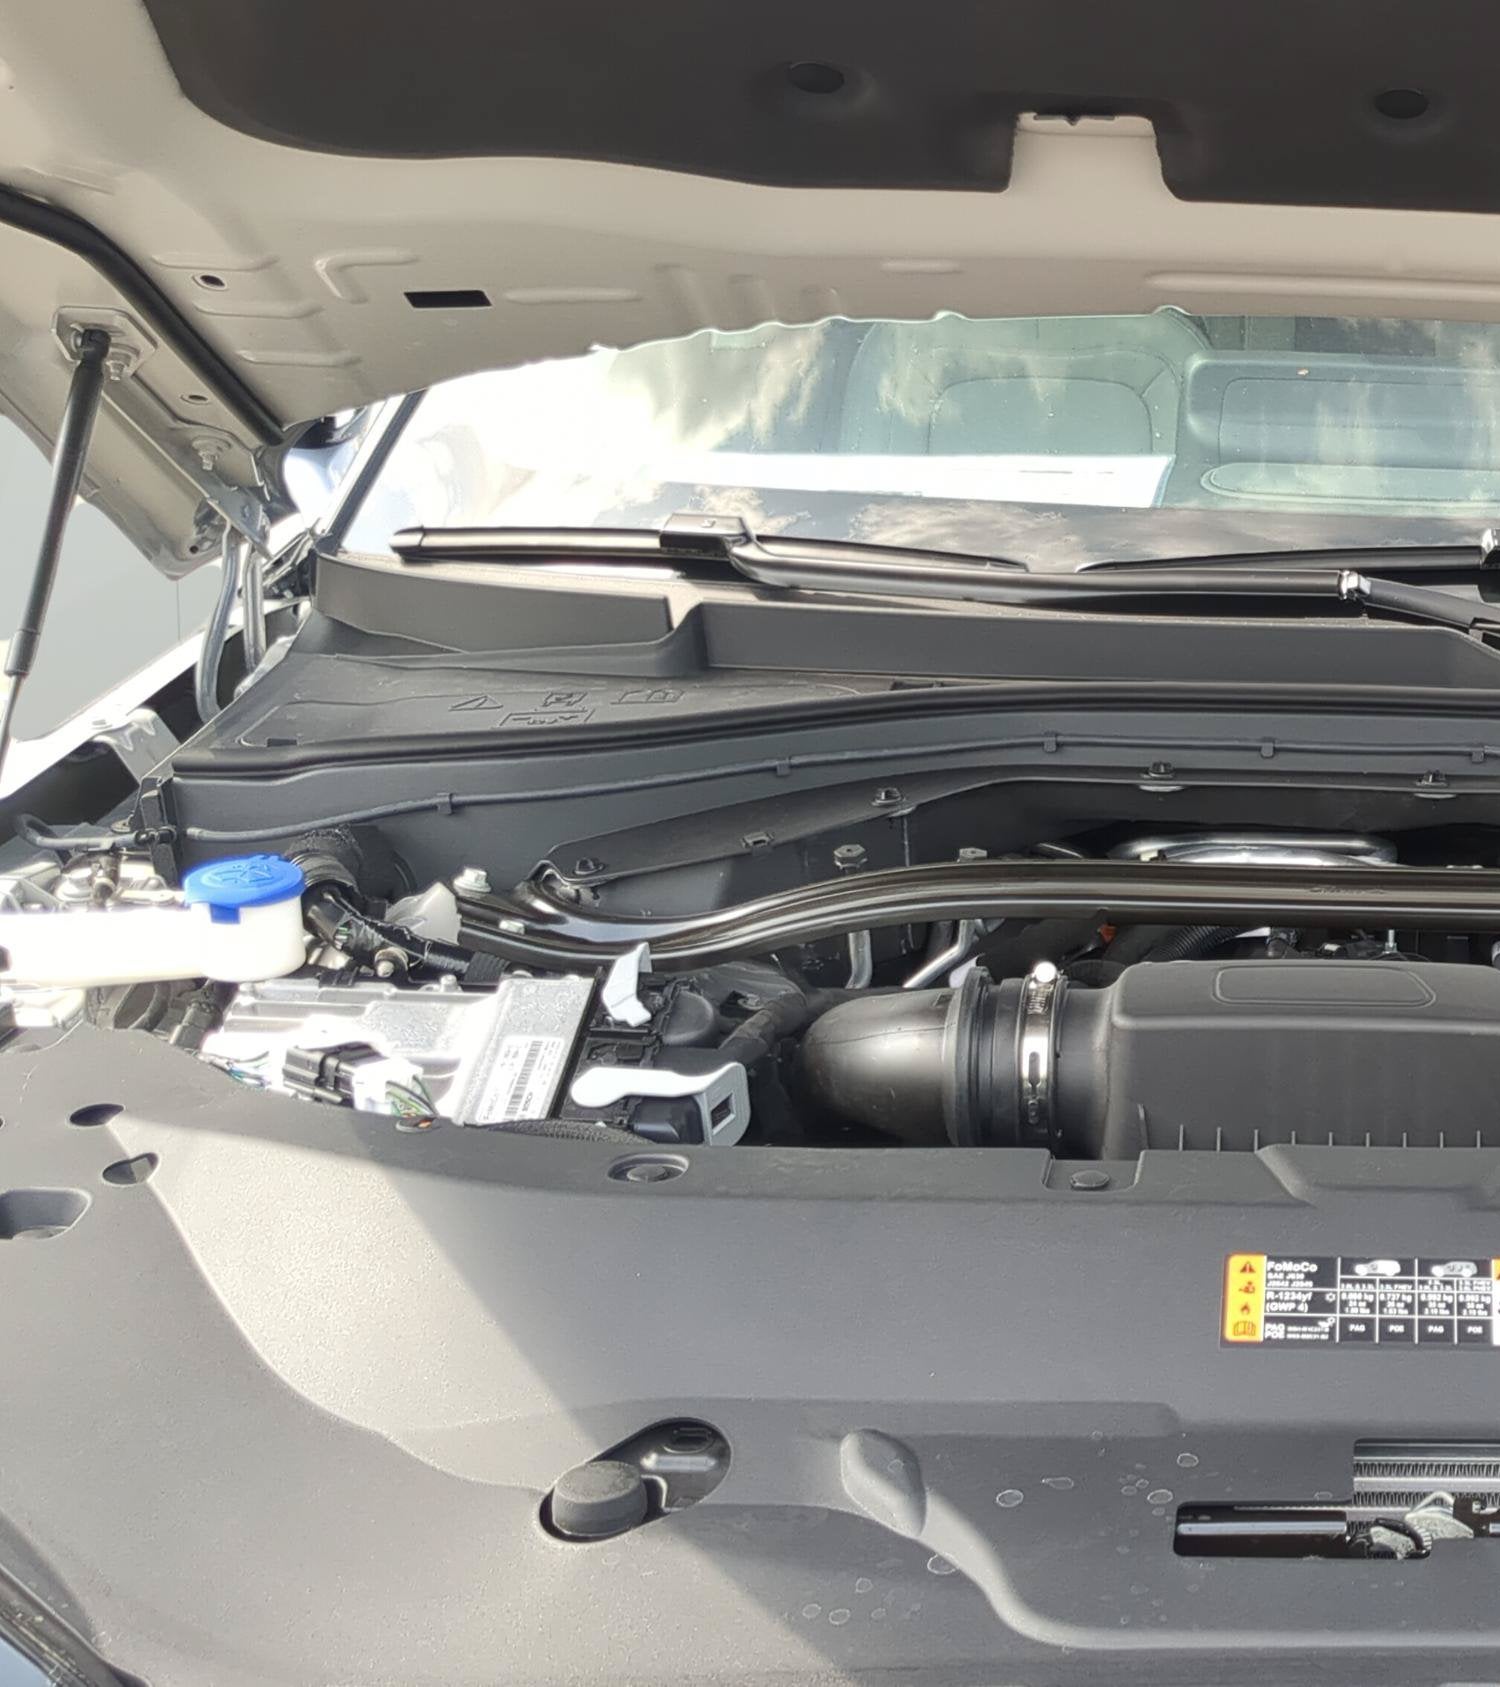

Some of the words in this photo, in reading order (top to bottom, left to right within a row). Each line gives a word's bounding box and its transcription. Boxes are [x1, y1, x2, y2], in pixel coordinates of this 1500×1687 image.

[1267, 1261, 1318, 1272] FoMoCo
[1267, 1272, 1284, 1280] SAE
[1266, 1291, 1313, 1302] R-1234yf
[1364, 1293, 1374, 1302] kg
[1401, 1294, 1412, 1303] kg
[1442, 1294, 1453, 1303] kg
[1481, 1295, 1491, 1304] kg
[1266, 1302, 1296, 1313] (GWP
[1297, 1302, 1309, 1313] 4)
[1265, 1323, 1285, 1331] PAG
[1349, 1324, 1366, 1332] PAG
[1389, 1325, 1404, 1333] POE
[1428, 1325, 1444, 1333] PAG
[1467, 1326, 1483, 1334] POE
[1265, 1331, 1285, 1339] POE
